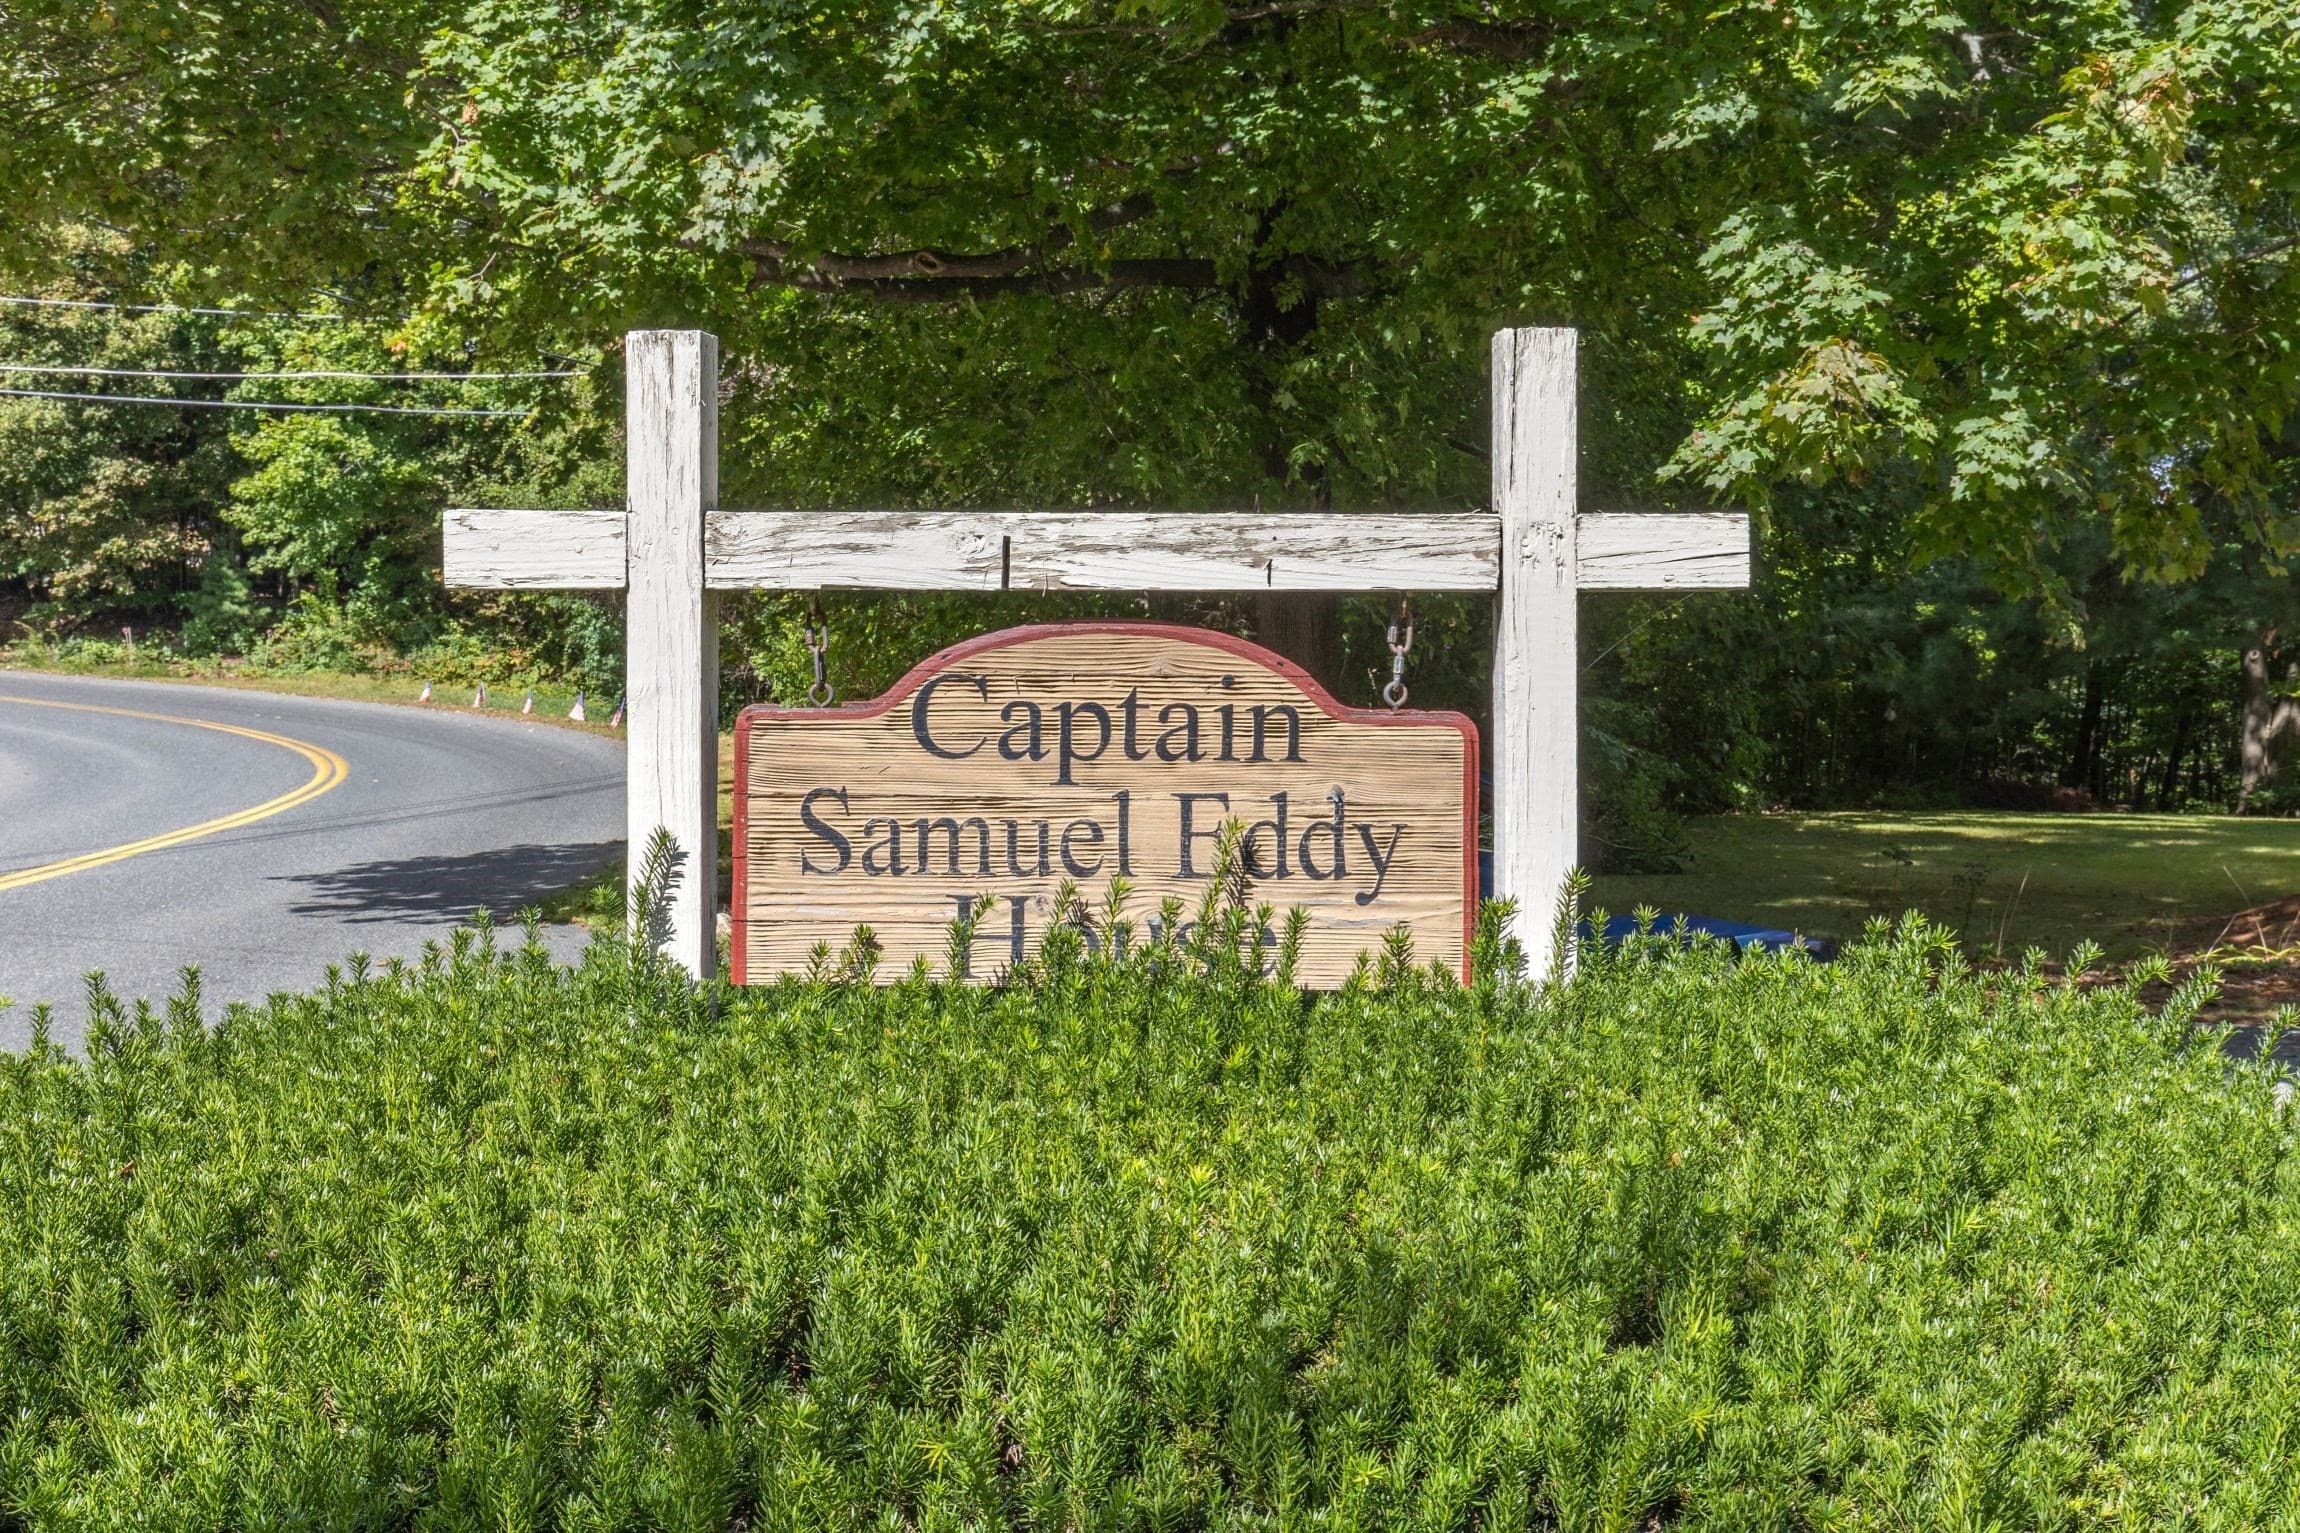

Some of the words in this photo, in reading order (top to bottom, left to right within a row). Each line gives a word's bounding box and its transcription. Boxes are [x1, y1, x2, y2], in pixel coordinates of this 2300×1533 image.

[912, 674, 1307, 786] Captain
[800, 786, 1137, 878] Samuel
[1170, 785, 1408, 906] Eddy
